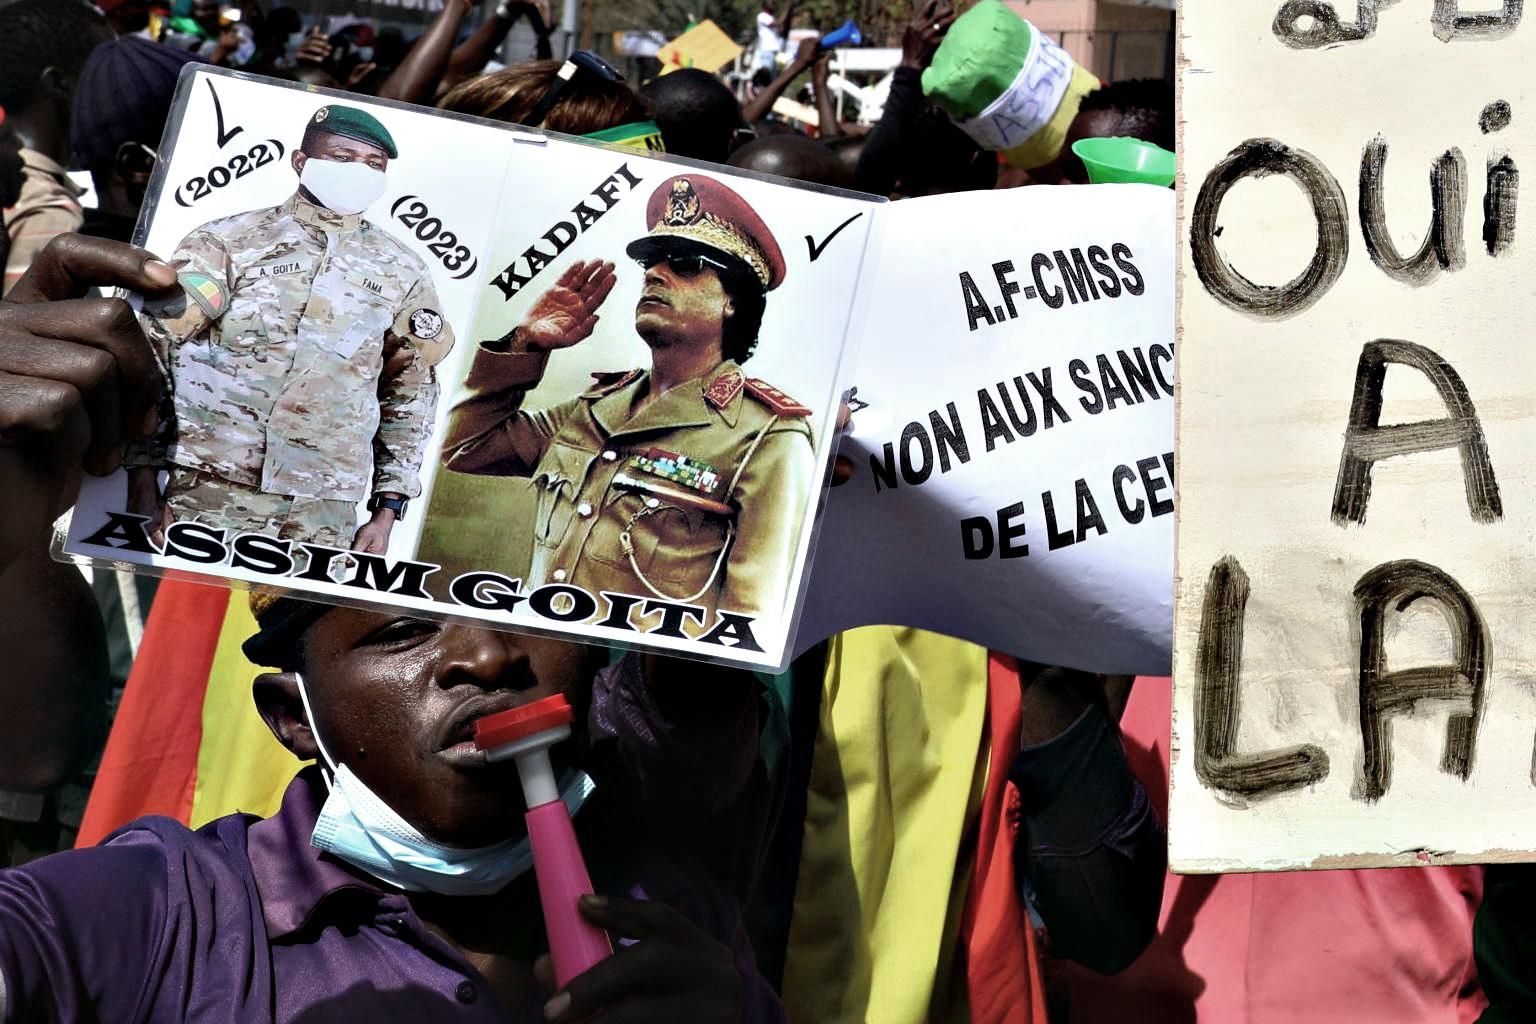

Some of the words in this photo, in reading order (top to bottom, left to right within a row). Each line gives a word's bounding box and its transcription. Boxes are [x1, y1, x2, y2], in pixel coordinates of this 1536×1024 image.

[174, 138, 285, 207] (2022)
[272, 262, 301, 276] GOITA
[390, 195, 478, 280] (2023)
[488, 161, 644, 302] KADAFI
[361, 278, 383, 295] FAMA
[959, 242, 1145, 331] A.F-CMSS
[869, 401, 971, 494] NON
[977, 366, 1072, 452] AUX
[1068, 342, 1175, 415] SANC
[1329, 338, 1502, 526] A
[960, 501, 1029, 560] DE
[1041, 478, 1108, 551] LA
[79, 511, 441, 600] ASSIM
[451, 572, 766, 653] GOITA
[1194, 555, 1493, 808] LA
